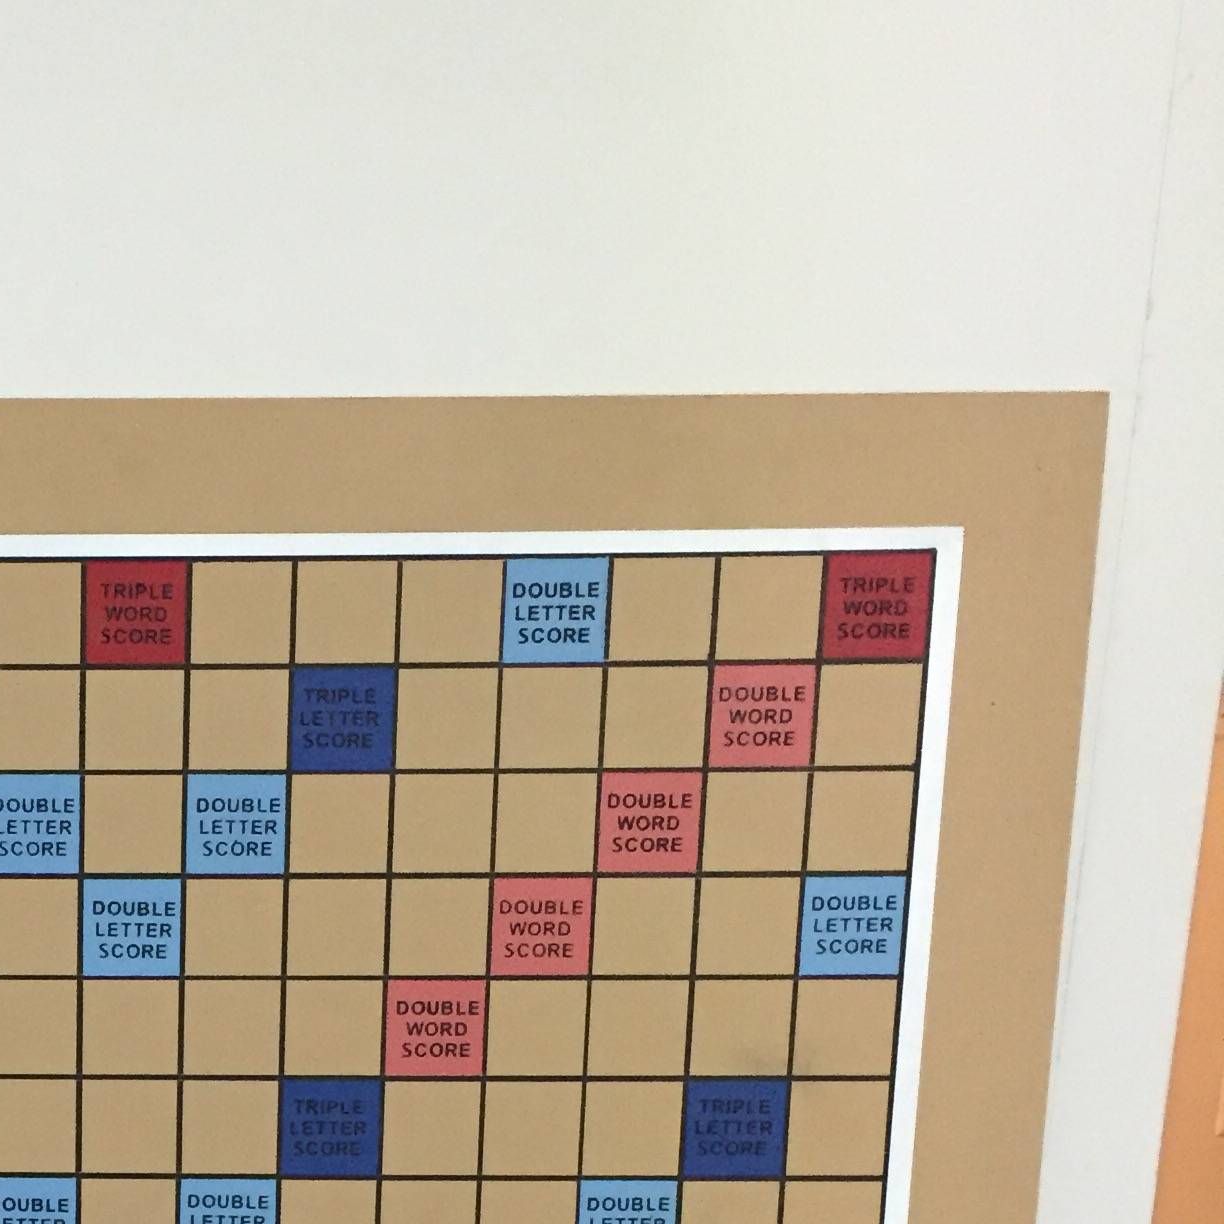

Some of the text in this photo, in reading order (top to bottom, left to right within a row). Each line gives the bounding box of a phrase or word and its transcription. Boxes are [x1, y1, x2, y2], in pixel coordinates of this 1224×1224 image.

[100, 582, 173, 600] TRIPLE
[512, 581, 600, 599] DOUBLE
[839, 576, 915, 594] TRIPLE
[104, 605, 167, 622] WORD
[515, 604, 595, 621] LETTER
[842, 598, 909, 617] WORD
[101, 627, 172, 645] SCORE
[518, 627, 590, 644] SCORE
[836, 621, 910, 640] SCORE
[718, 686, 806, 702] DOUBLE
[728, 708, 793, 725] WORD
[723, 730, 794, 747] SCORE
[499, 899, 583, 915] DOUBLE
[811, 895, 898, 911] DOUBLE
[508, 921, 571, 936] WORD
[813, 917, 893, 933] LETTER
[504, 943, 573, 958] SCORE
[815, 938, 887, 954] SCORE
[294, 1098, 363, 1115] TRIPLE
[289, 1119, 366, 1137] LETTER
[293, 1140, 360, 1157] SCORE
[187, 1194, 268, 1210] DOUBLE
